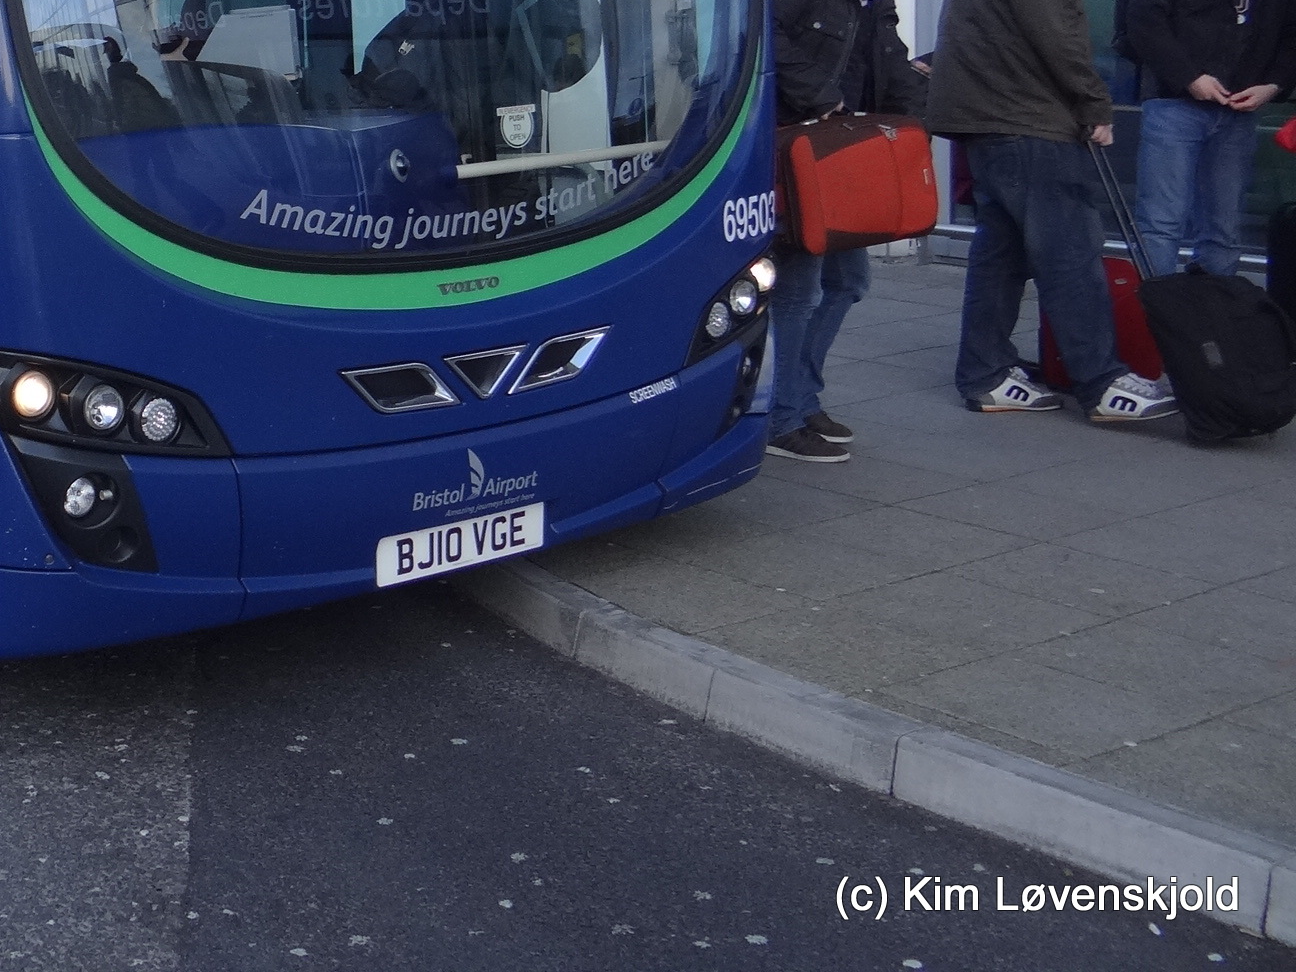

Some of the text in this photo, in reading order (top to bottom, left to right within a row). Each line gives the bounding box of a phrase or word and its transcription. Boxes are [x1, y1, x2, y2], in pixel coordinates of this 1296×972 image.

[239, 146, 654, 249] Amazing journeys start here
[723, 189, 776, 242] 69503
[436, 276, 501, 296] VOLVO
[628, 377, 677, 404] SCREENWASH
[412, 470, 539, 511] Bristol Airport
[396, 511, 526, 576] BJ10 VGE
